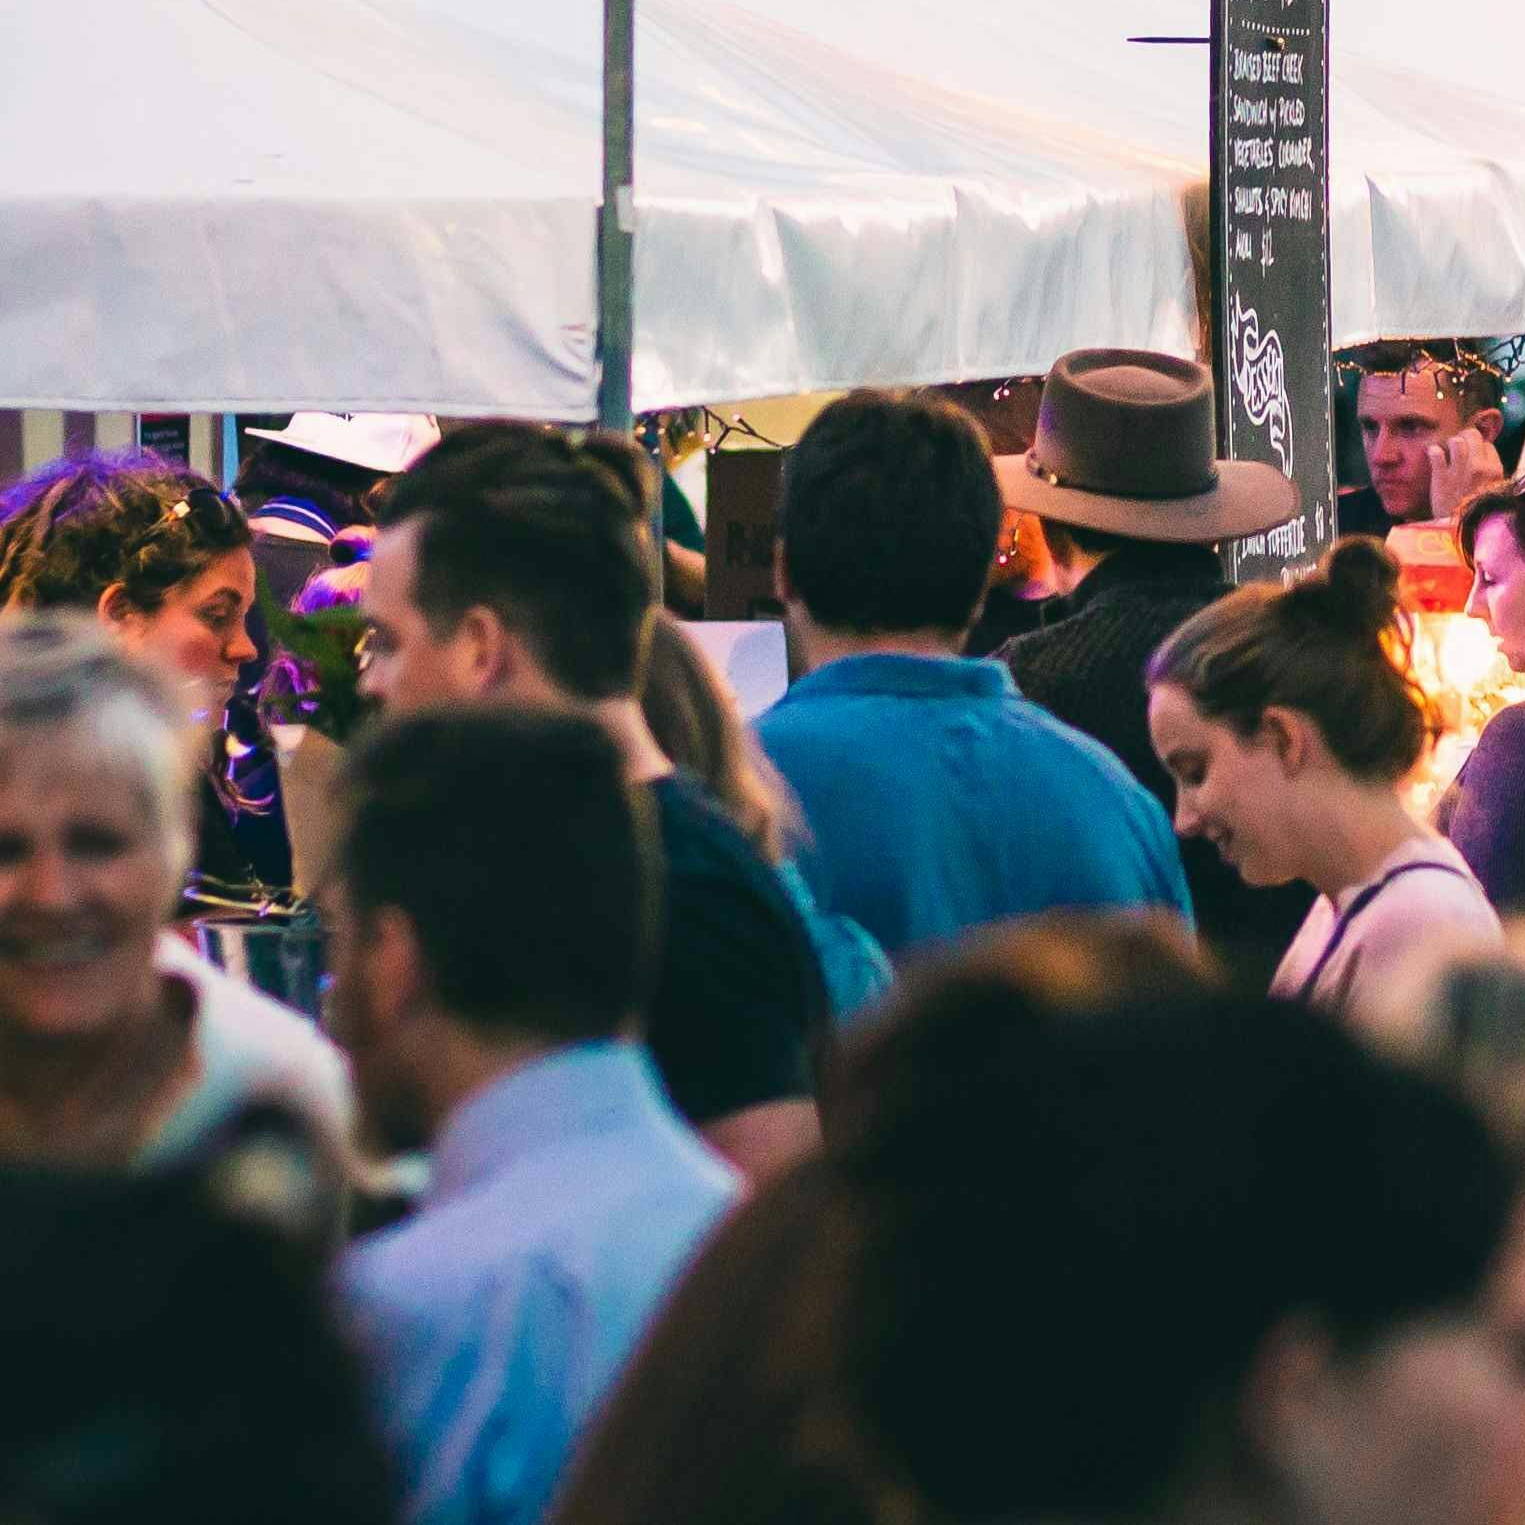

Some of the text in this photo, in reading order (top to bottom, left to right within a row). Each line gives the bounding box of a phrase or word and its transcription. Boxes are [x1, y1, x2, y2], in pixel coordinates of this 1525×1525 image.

[1262, 51, 1281, 84] BEEF
[1282, 52, 1303, 85] CHEEK
[1233, 94, 1267, 126] SANDWICH
